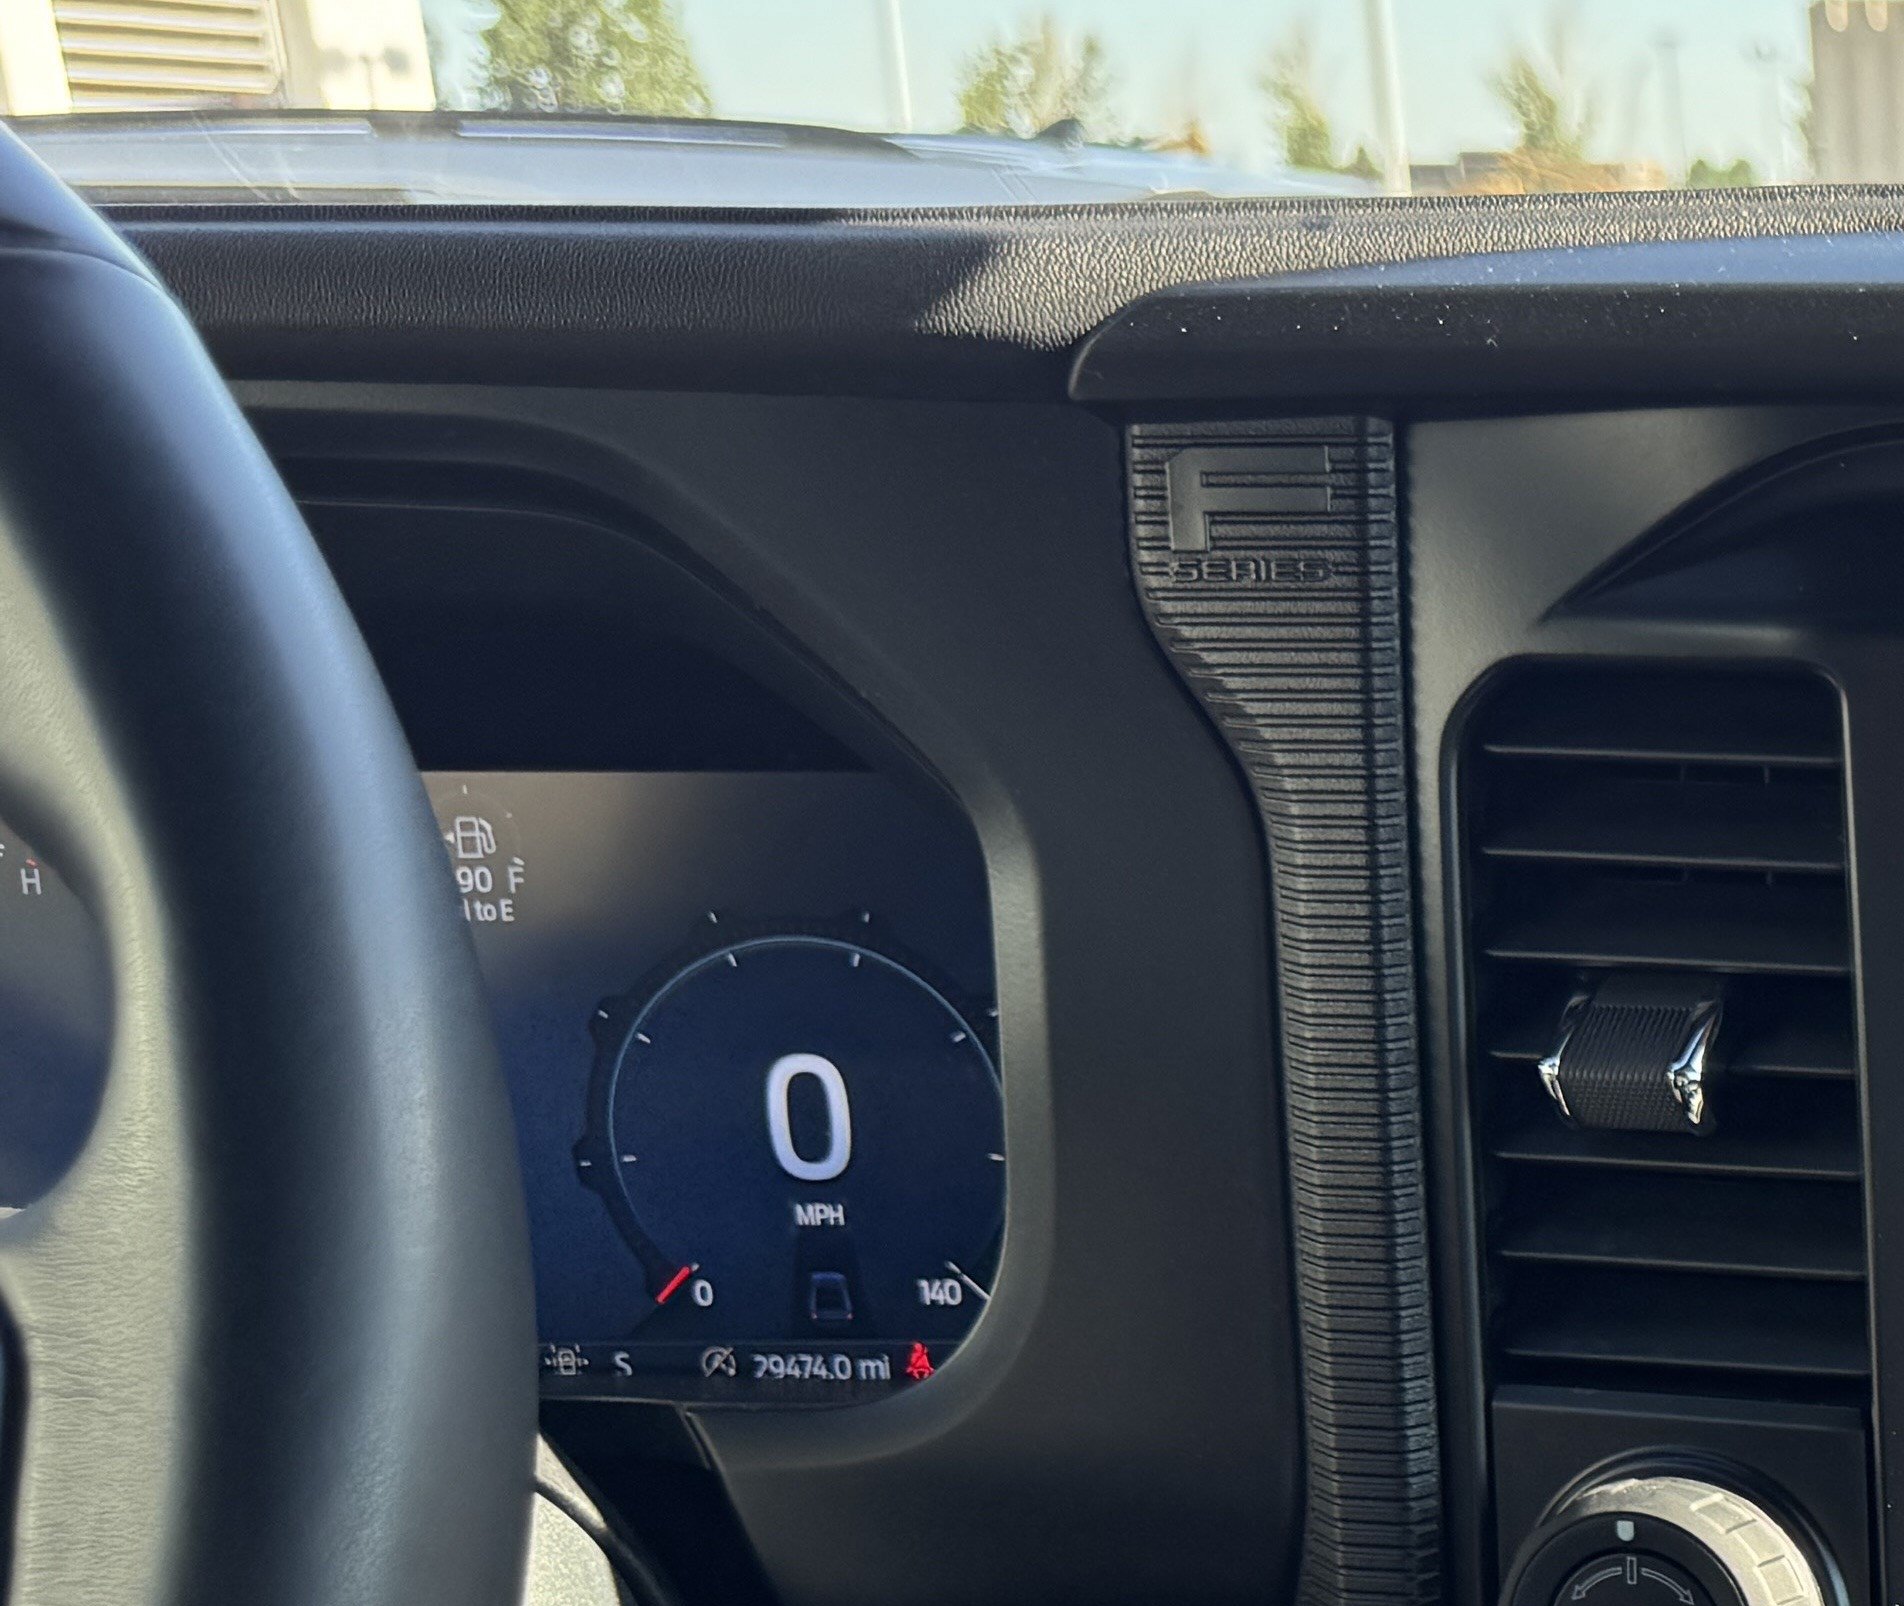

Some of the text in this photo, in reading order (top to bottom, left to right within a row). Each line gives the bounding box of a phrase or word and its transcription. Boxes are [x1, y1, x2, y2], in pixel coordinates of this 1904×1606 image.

[1172, 558, 1333, 584] SERIES
[20, 868, 41, 895] H
[508, 866, 524, 893] F
[473, 900, 497, 921] to
[500, 899, 515, 921] E
[765, 1052, 851, 1181] 0
[795, 1204, 845, 1227] MPH
[691, 1279, 714, 1306] 0
[917, 1279, 962, 1306] 140
[614, 1353, 633, 1376] S
[859, 1354, 891, 1380] mi
